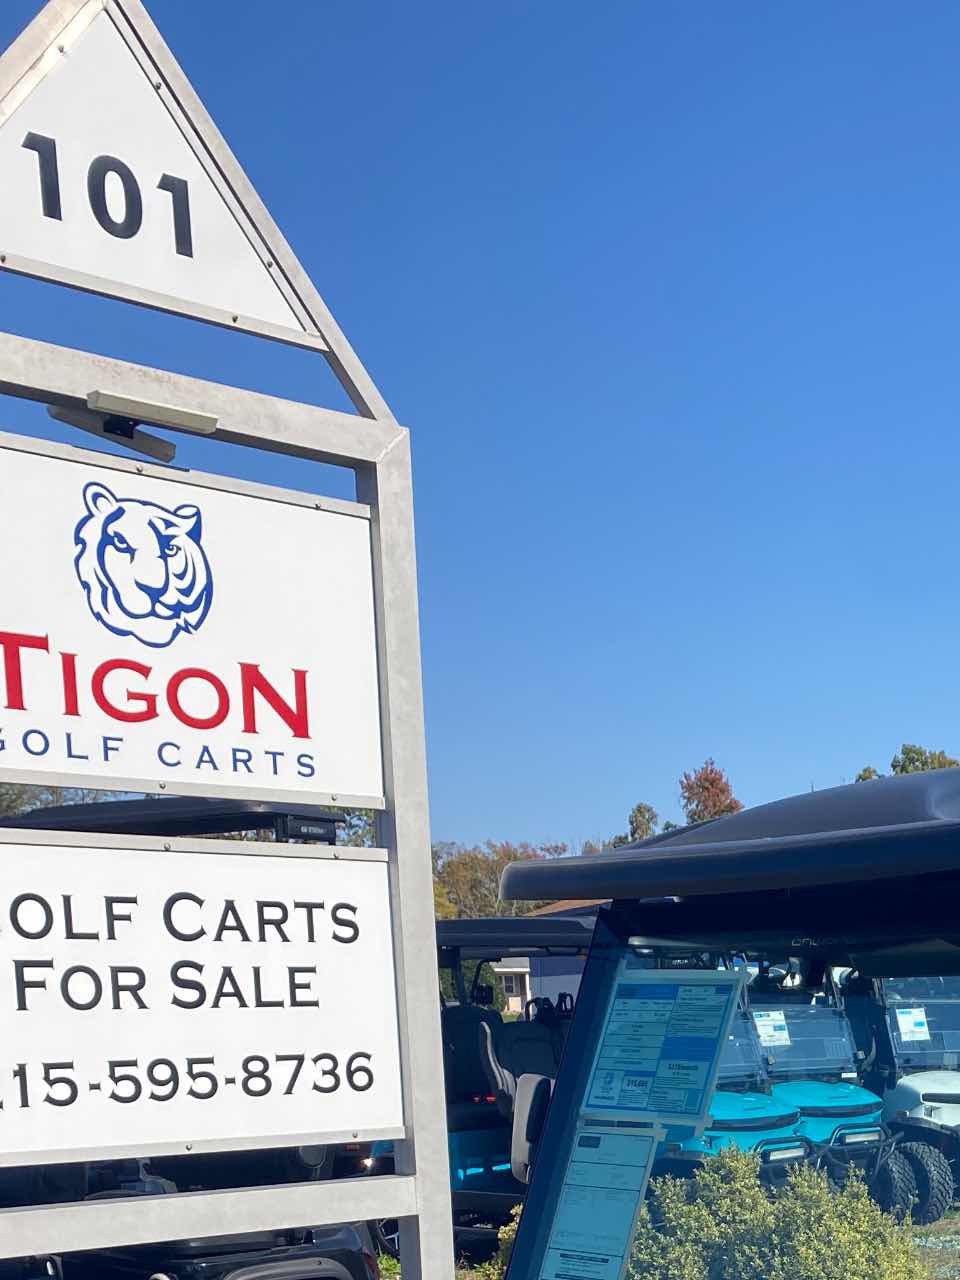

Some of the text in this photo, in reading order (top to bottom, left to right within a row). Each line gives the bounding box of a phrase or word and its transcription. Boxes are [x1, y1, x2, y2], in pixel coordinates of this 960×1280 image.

[22, 131, 193, 258] 101
[0, 631, 311, 739] TIGON
[157, 741, 315, 778] CARTS
[0, 891, 360, 944] OLF CARTS
[12, 958, 320, 1012] FOR SALE
[0, 1051, 374, 1111] 15-595-8736
